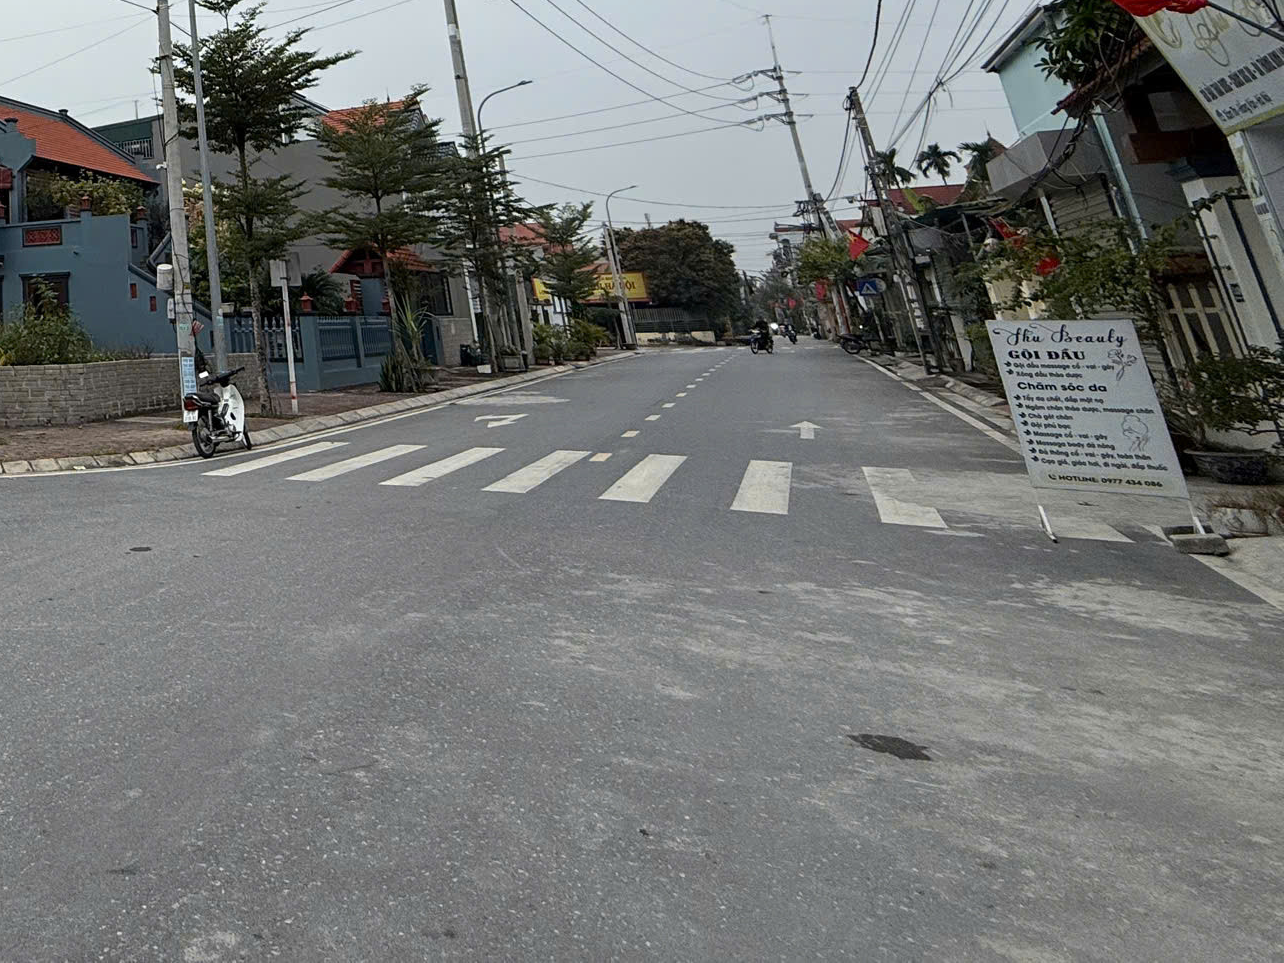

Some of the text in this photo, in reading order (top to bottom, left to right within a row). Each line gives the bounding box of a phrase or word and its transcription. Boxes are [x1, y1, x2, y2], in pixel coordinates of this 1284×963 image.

[1029, 324, 1128, 347] Beauty
[1008, 350, 1040, 360] GỘI
[1017, 382, 1057, 391] Chăm
[1061, 383, 1084, 392] sóc
